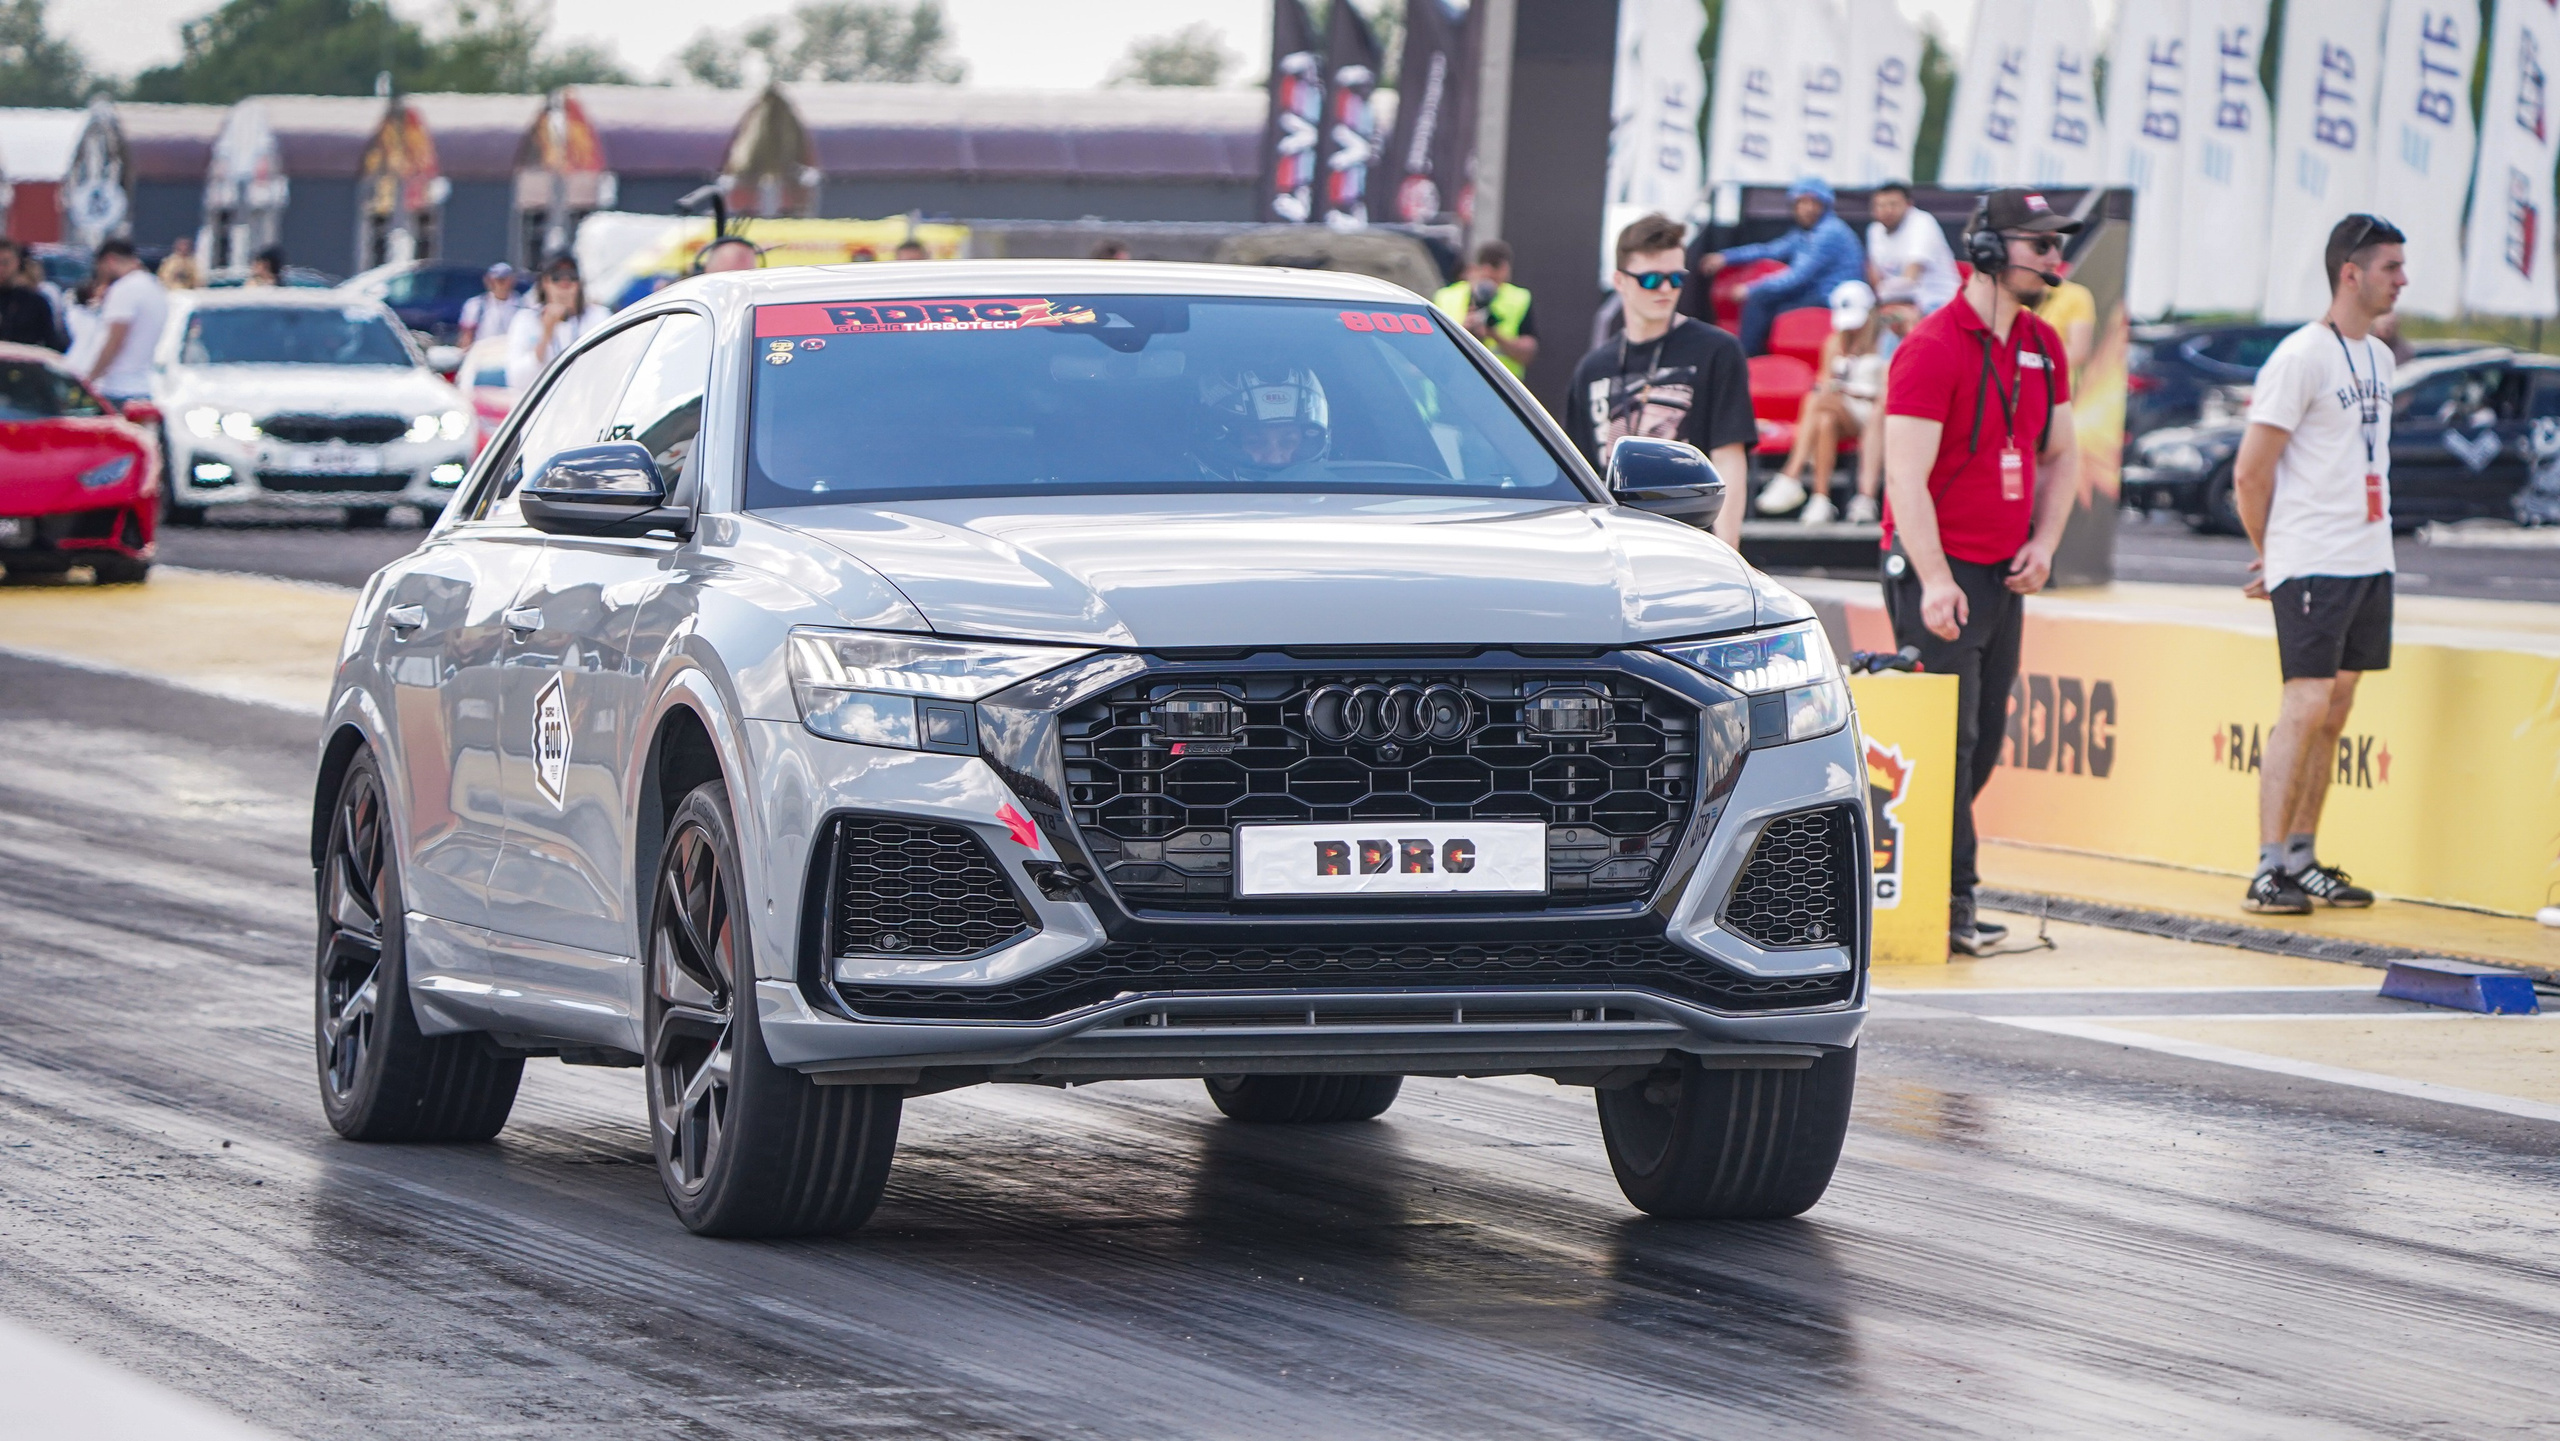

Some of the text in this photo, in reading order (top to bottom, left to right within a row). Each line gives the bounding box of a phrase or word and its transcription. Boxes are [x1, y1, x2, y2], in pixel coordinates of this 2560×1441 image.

[2315, 40, 2356, 150] ВТБ
[822, 303, 1024, 326] RDRC
[1340, 312, 1434, 335] 800
[545, 721, 561, 759] 800
[1313, 838, 1477, 876] RDRC
